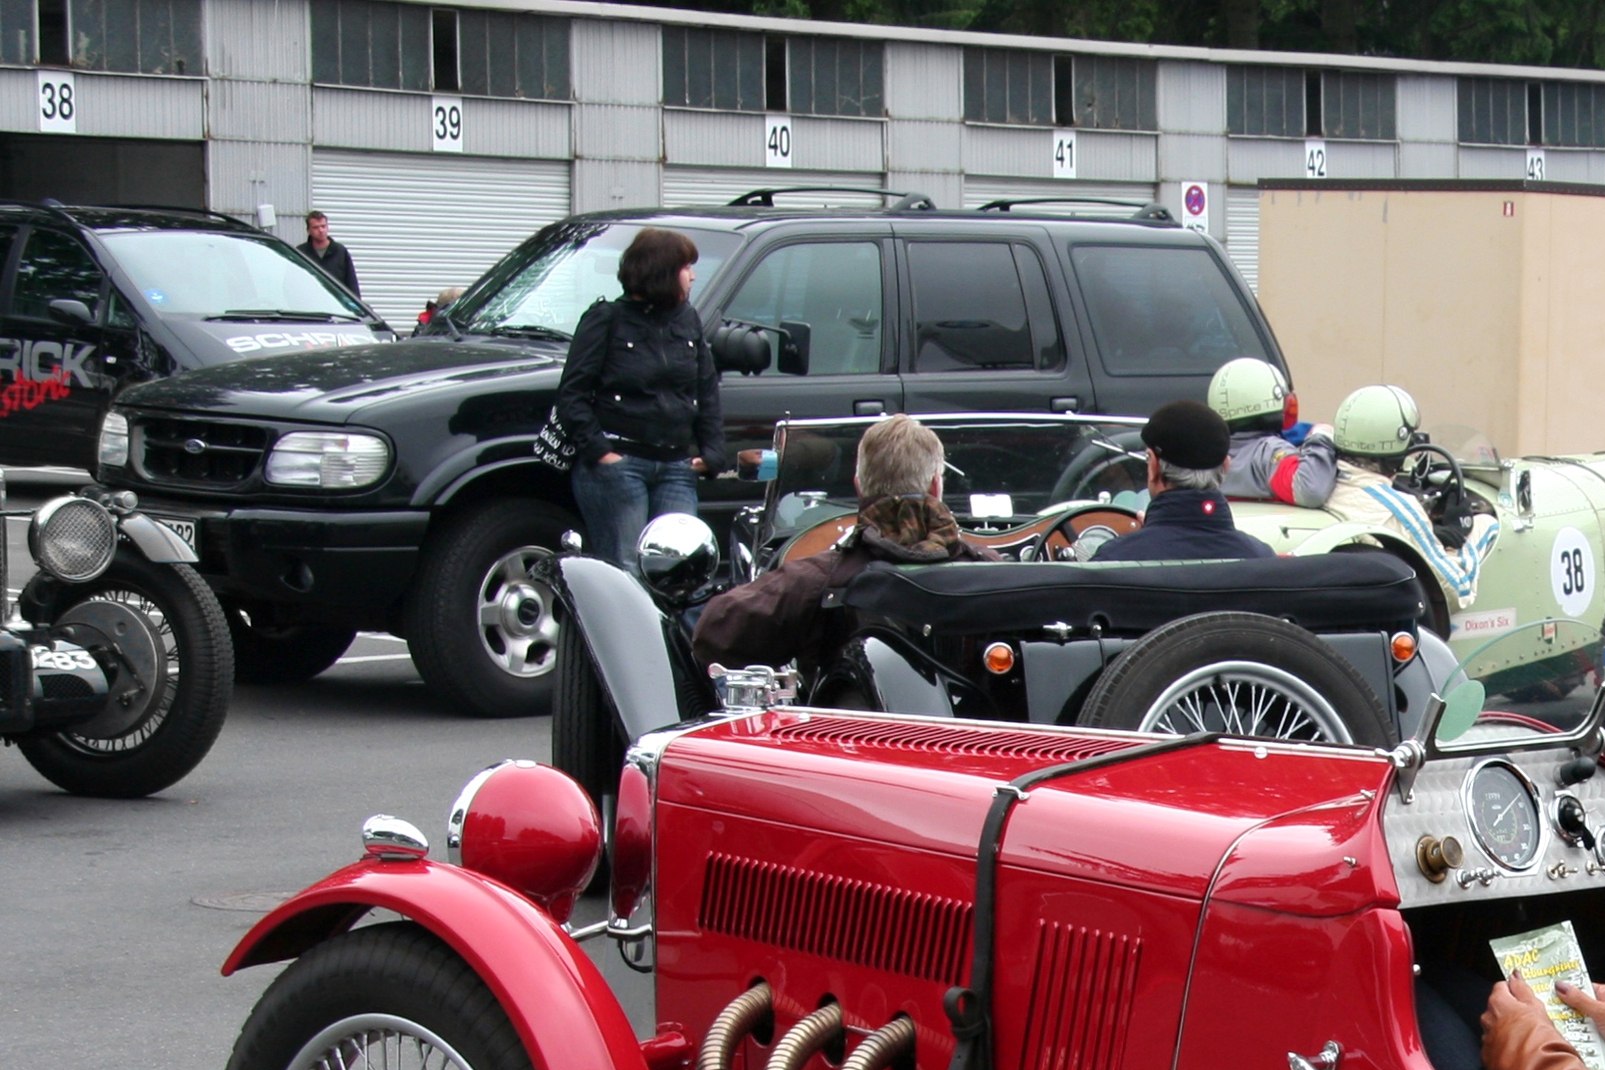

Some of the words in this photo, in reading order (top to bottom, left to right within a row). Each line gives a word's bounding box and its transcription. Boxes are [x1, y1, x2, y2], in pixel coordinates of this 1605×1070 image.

[41, 82, 74, 121] 38
[434, 105, 461, 140] 39
[767, 125, 791, 158] 40
[1055, 139, 1073, 168] 41
[1307, 149, 1325, 177] 42
[1527, 157, 1544, 181] 43
[1219, 403, 1262, 418] Sprite
[1560, 547, 1585, 597] 38
[1464, 618, 1495, 631] Dixon's
[1496, 616, 1510, 628] Six
[1503, 949, 1540, 969] ADAC
